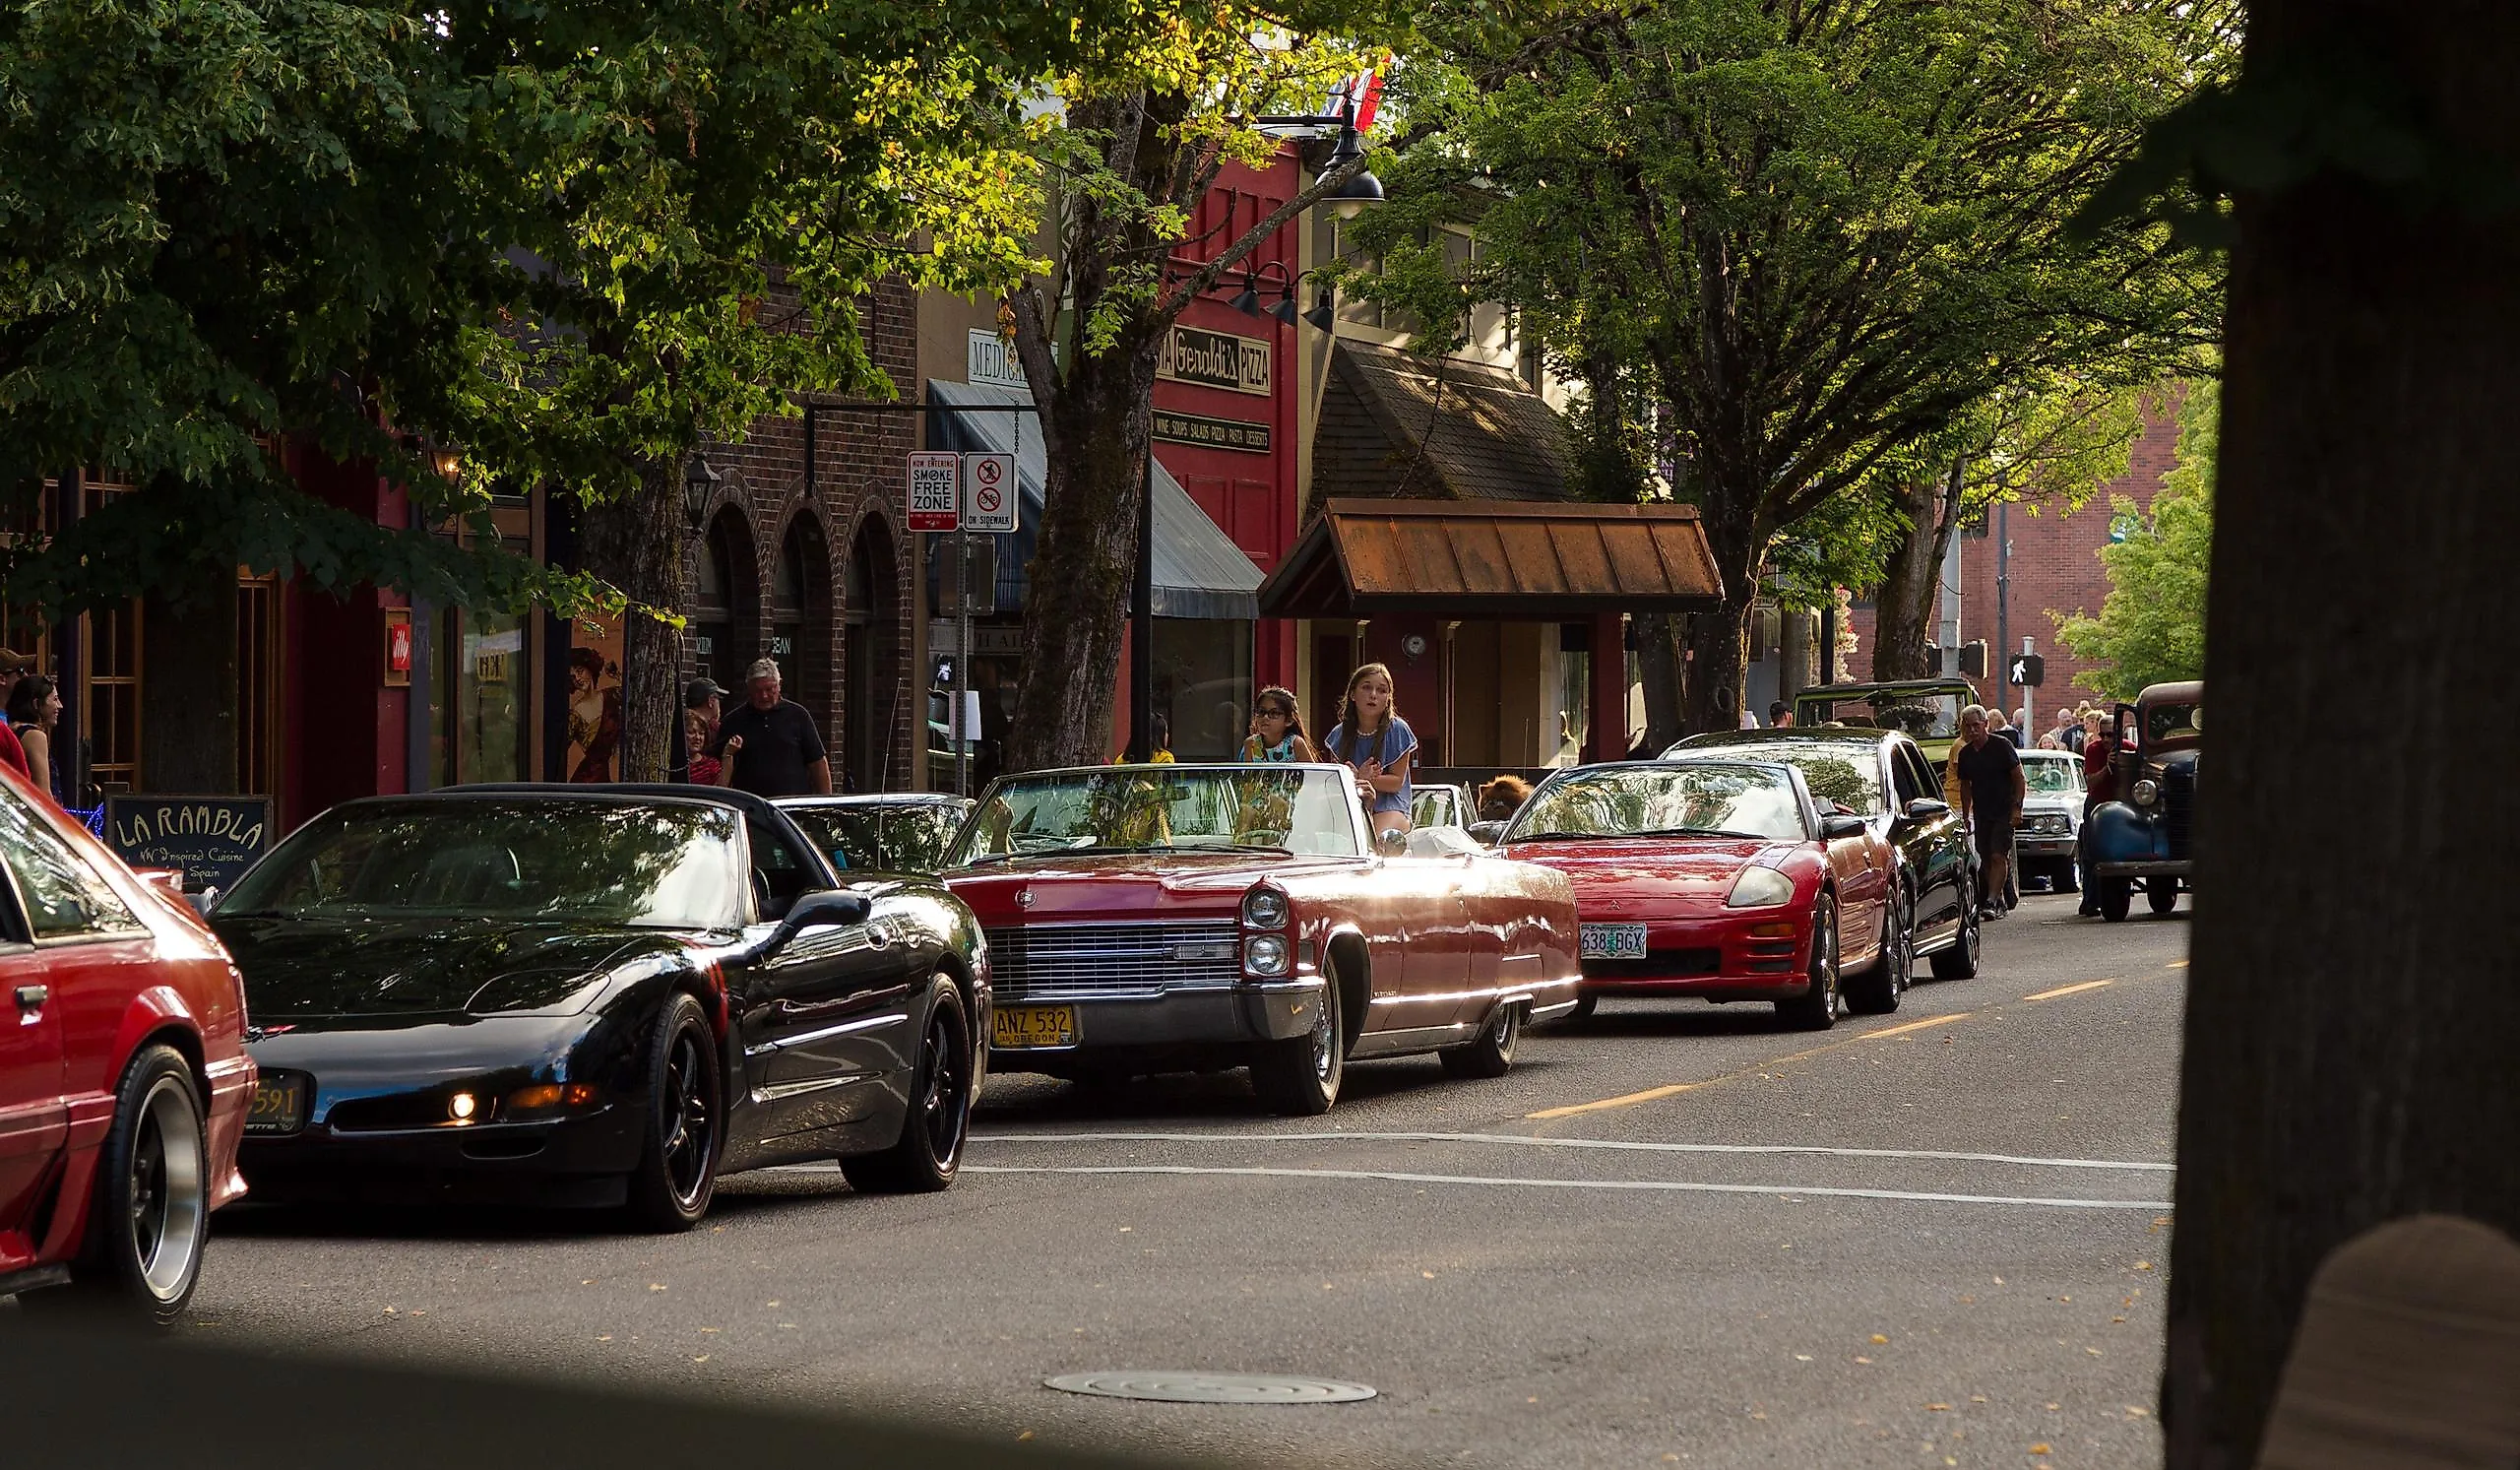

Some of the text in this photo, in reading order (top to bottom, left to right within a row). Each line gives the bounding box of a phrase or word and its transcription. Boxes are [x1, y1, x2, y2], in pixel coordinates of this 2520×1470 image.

[1175, 332, 1238, 381] Geraldi's
[1240, 346, 1269, 387] PIZZA
[1157, 417, 1269, 448] WINE SOUPS SALADS PIZZA PASTA DESSERTS
[913, 470, 953, 481] SMOKE
[914, 481, 951, 495] FREE
[913, 495, 952, 510] ZONE
[968, 516, 1010, 525] ON SIDEWALK
[394, 629, 410, 665] illy
[116, 805, 263, 850] LA RAMBLA
[159, 848, 205, 867] Inspired
[209, 847, 245, 863] Cuisine
[190, 865, 220, 882] Spain
[1582, 932, 1642, 950] 638 BGX
[997, 1011, 1068, 1035] ANZ 532
[1014, 1034, 1054, 1043] OREGON
